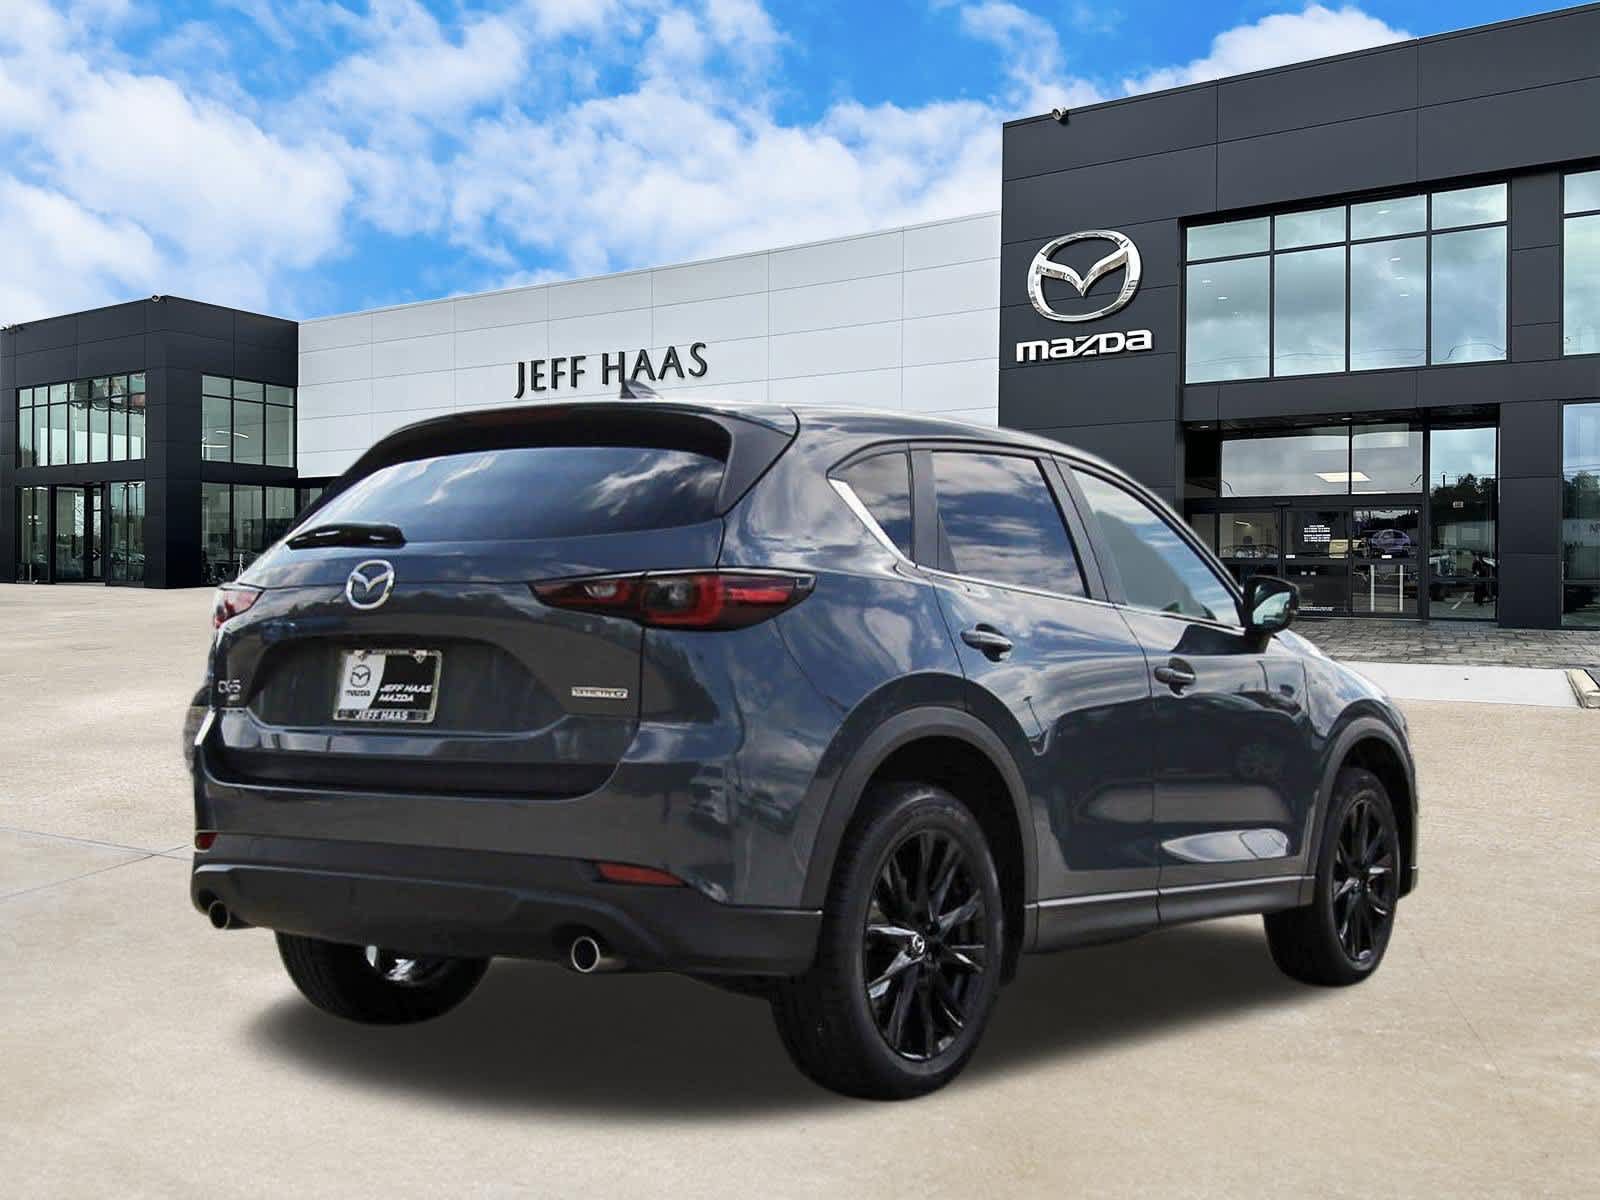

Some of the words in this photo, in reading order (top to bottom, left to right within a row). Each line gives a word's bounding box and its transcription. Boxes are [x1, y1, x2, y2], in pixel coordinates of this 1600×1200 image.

[514, 355, 587, 399] JEFF
[602, 342, 709, 385] HAAS
[380, 683, 405, 693] JEFF
[404, 684, 433, 693] HAAS
[378, 693, 414, 702] MAZDA
[355, 710, 381, 720] JEFF
[380, 710, 409, 720] HAAS
